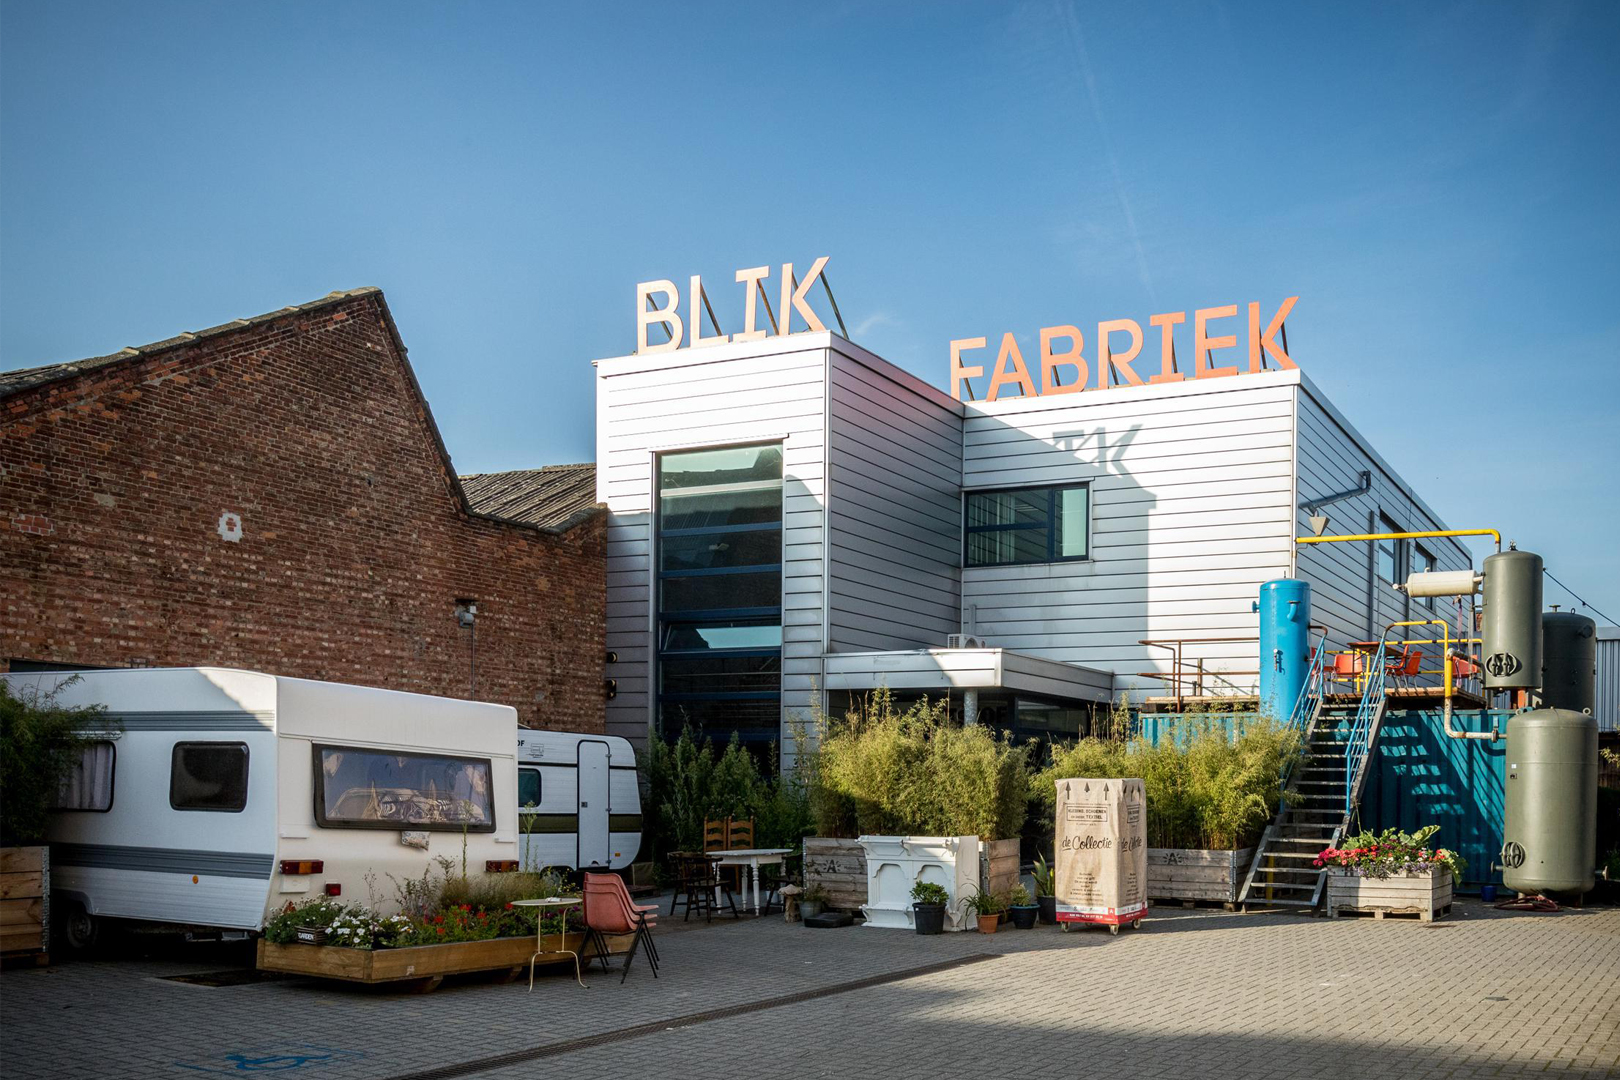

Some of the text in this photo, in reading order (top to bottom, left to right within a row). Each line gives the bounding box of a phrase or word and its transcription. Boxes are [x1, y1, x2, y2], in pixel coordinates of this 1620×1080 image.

[636, 256, 830, 355] BLIK
[950, 296, 1299, 401] FABRIEK
[1072, 835, 1112, 850] Collectie
